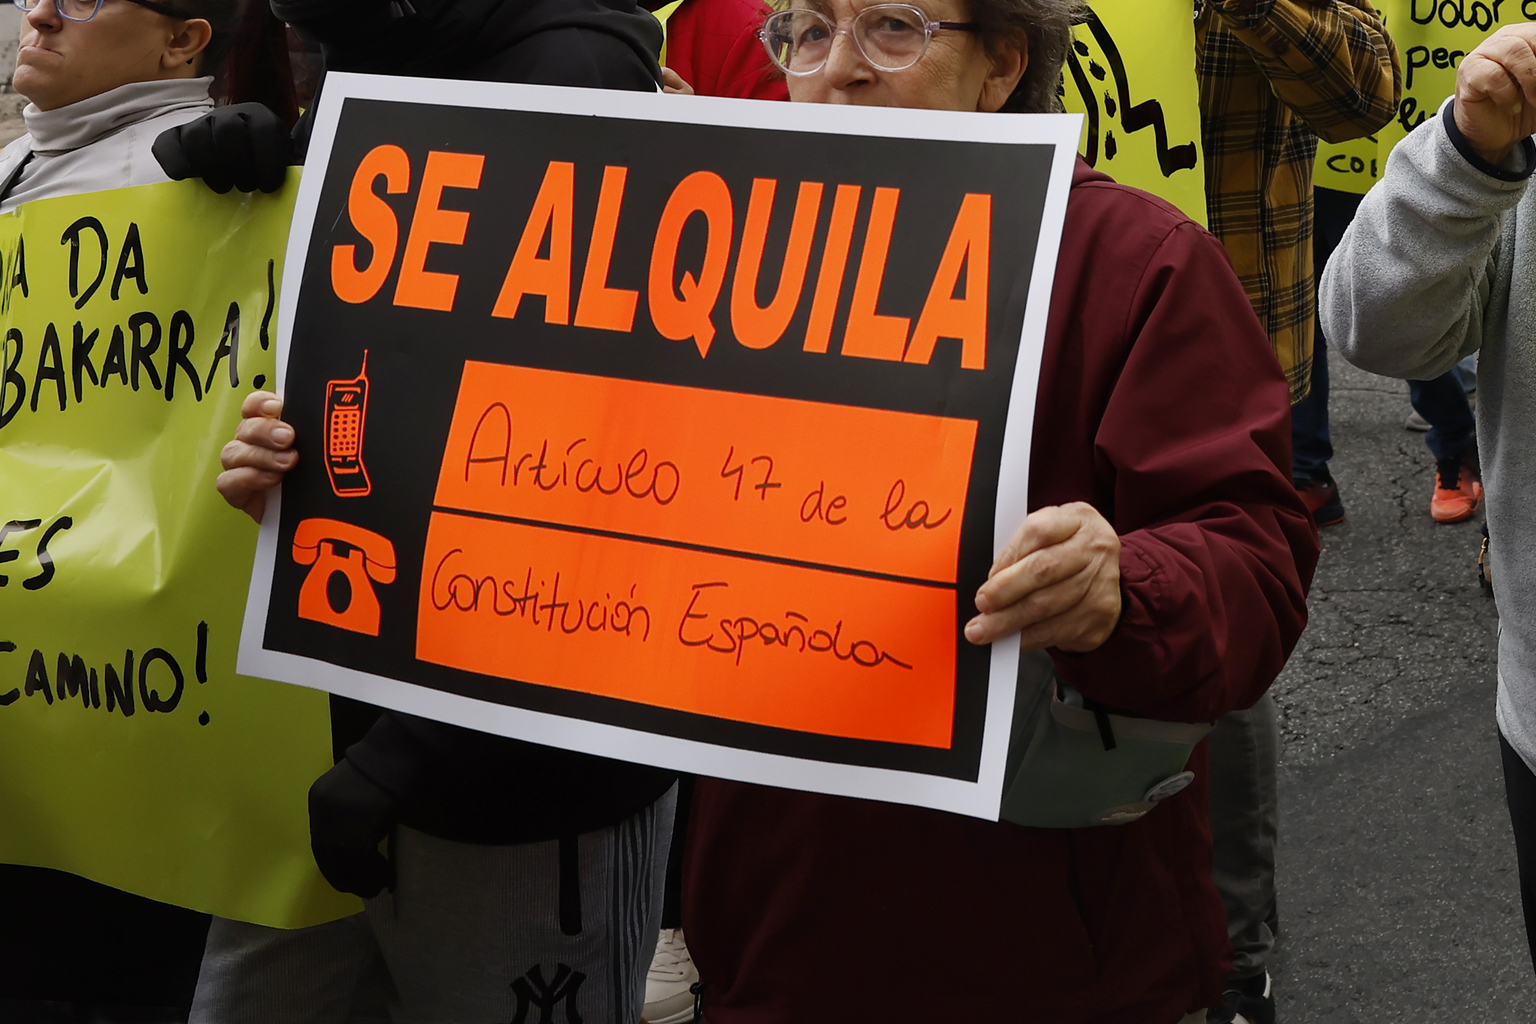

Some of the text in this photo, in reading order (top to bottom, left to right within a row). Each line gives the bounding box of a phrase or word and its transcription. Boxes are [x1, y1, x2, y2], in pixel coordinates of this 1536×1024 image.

[1405, 45, 1471, 91] per
[60, 215, 149, 311] DA
[330, 143, 992, 371] SE ALQUILA
[464, 401, 953, 532] Artículo 47 de la
[430, 548, 914, 671] Constitución Española
